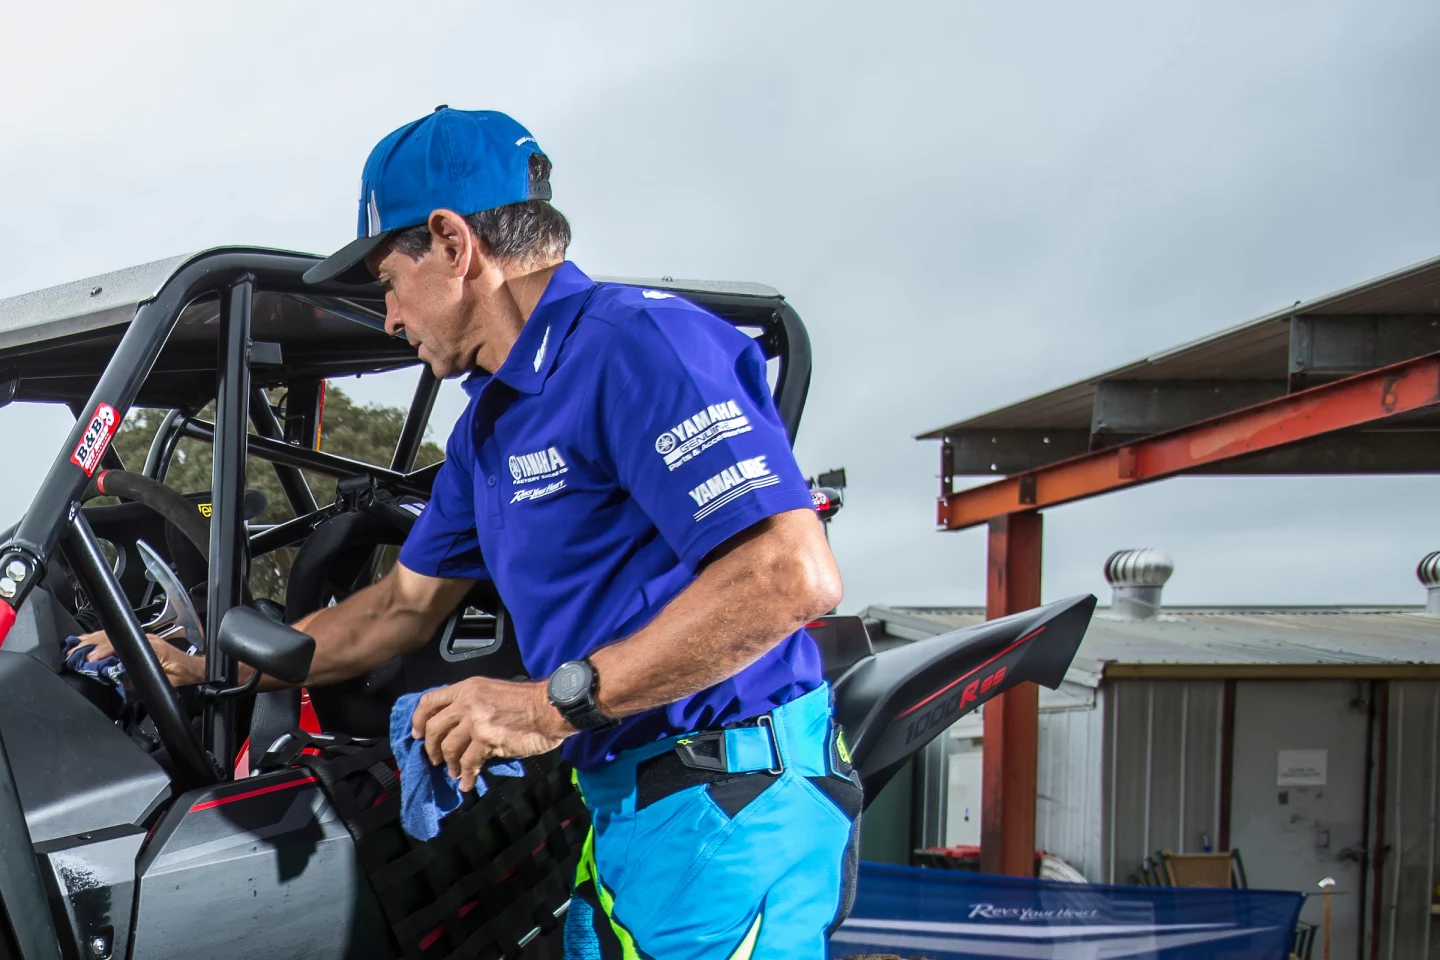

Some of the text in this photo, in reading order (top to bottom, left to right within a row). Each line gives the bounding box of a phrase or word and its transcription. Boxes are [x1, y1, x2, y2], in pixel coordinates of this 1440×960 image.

[671, 400, 742, 442] YAMAHA
[680, 421, 731, 453] GENUINE
[516, 447, 566, 478] YAMAHA
[668, 454, 693, 471] Parts
[692, 449, 701, 457] &
[688, 455, 771, 507] YAMALUBE
[968, 903, 1019, 919] Revs
[1019, 907, 1053, 921] Your
